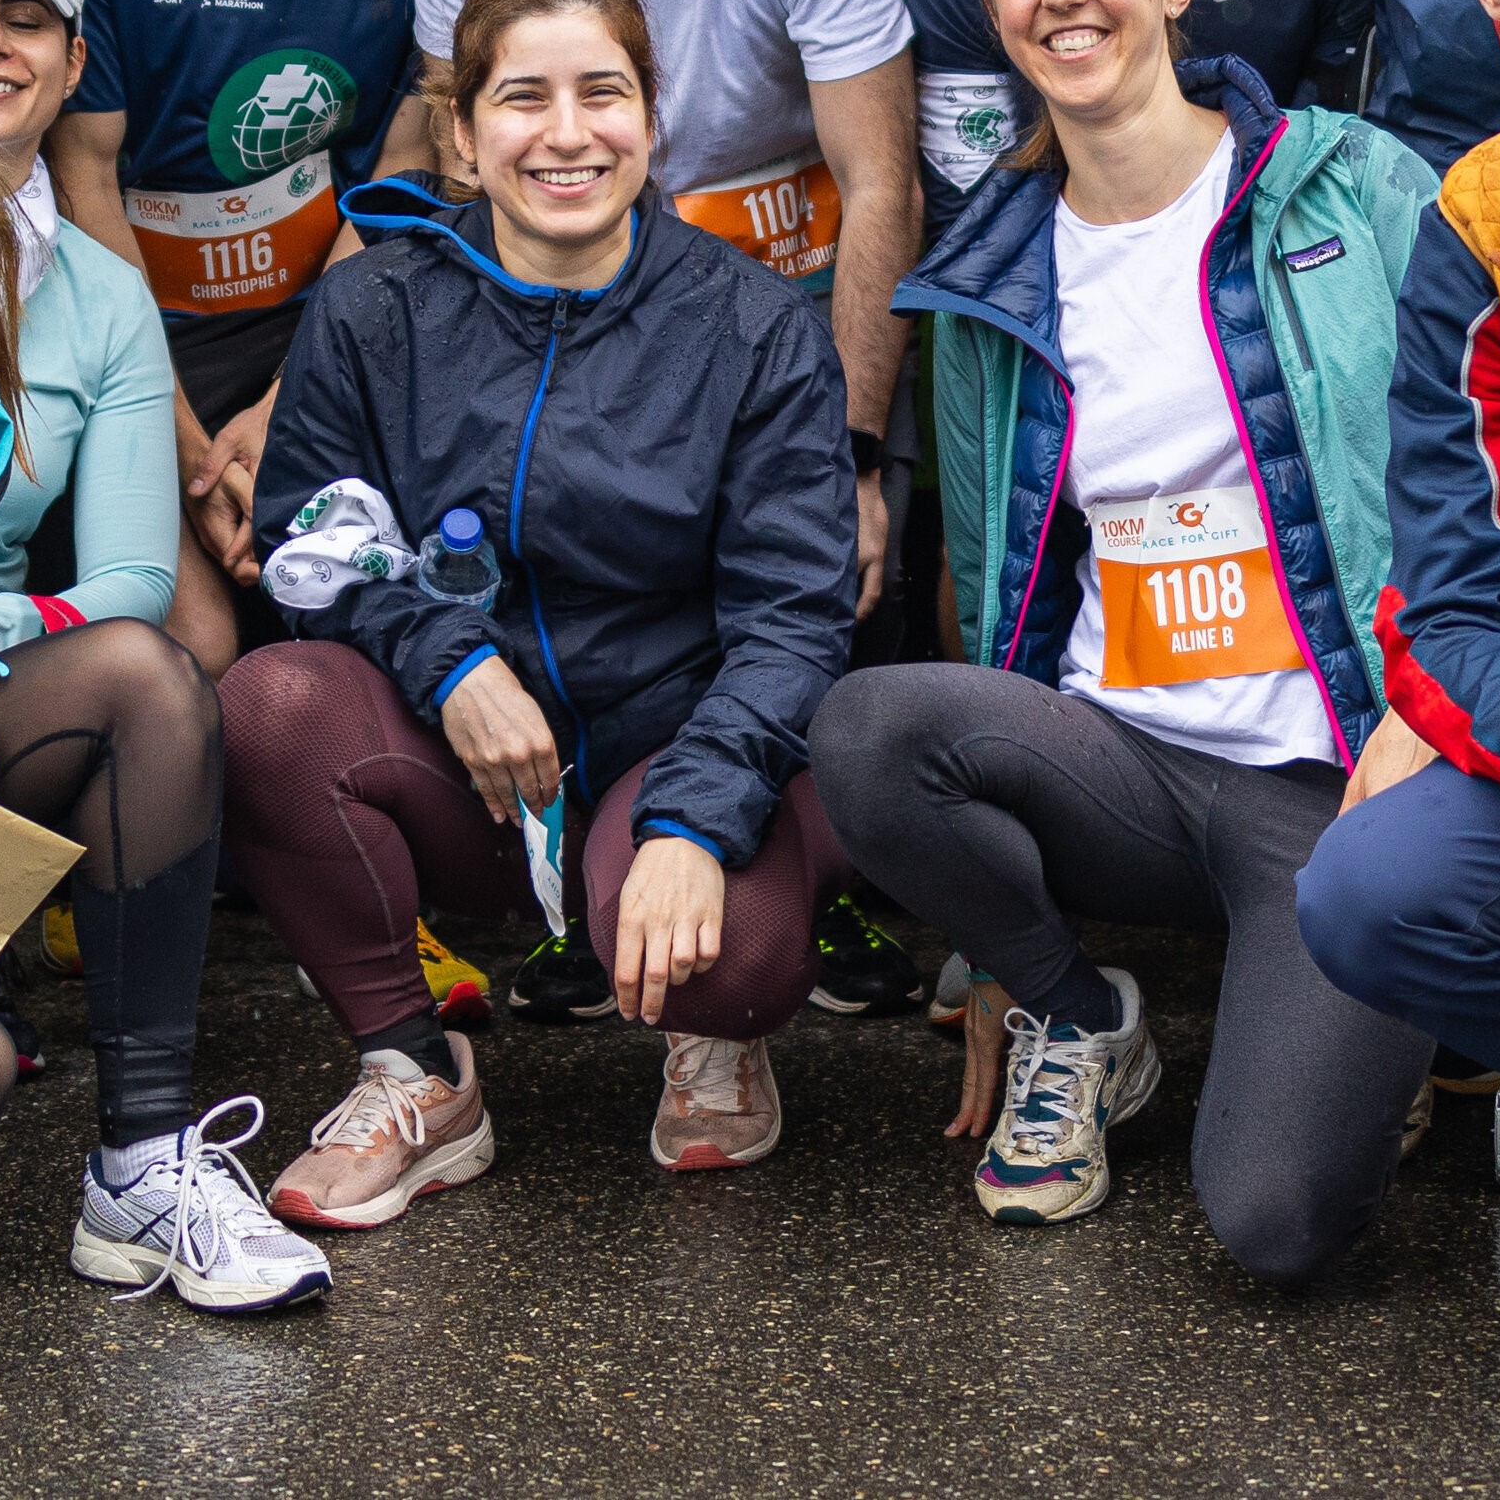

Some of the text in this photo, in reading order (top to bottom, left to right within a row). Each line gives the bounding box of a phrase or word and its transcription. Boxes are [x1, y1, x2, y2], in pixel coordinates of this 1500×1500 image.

[214, 0, 264, 10] MARATHON
[134, 198, 181, 216] 10KM
[140, 211, 177, 223] COURSE
[743, 177, 815, 239] 1104
[192, 207, 274, 230] RACE FOR GIFT
[198, 231, 274, 280] 1116
[191, 274, 275, 299] CHRISTOPHE
[1100, 518, 1144, 538] 10KM
[1107, 536, 1141, 548] COURSE
[1142, 529, 1239, 550] RACE FOR GIFT
[1147, 560, 1247, 627] 1108
[1171, 625, 1235, 654] ALINE B
